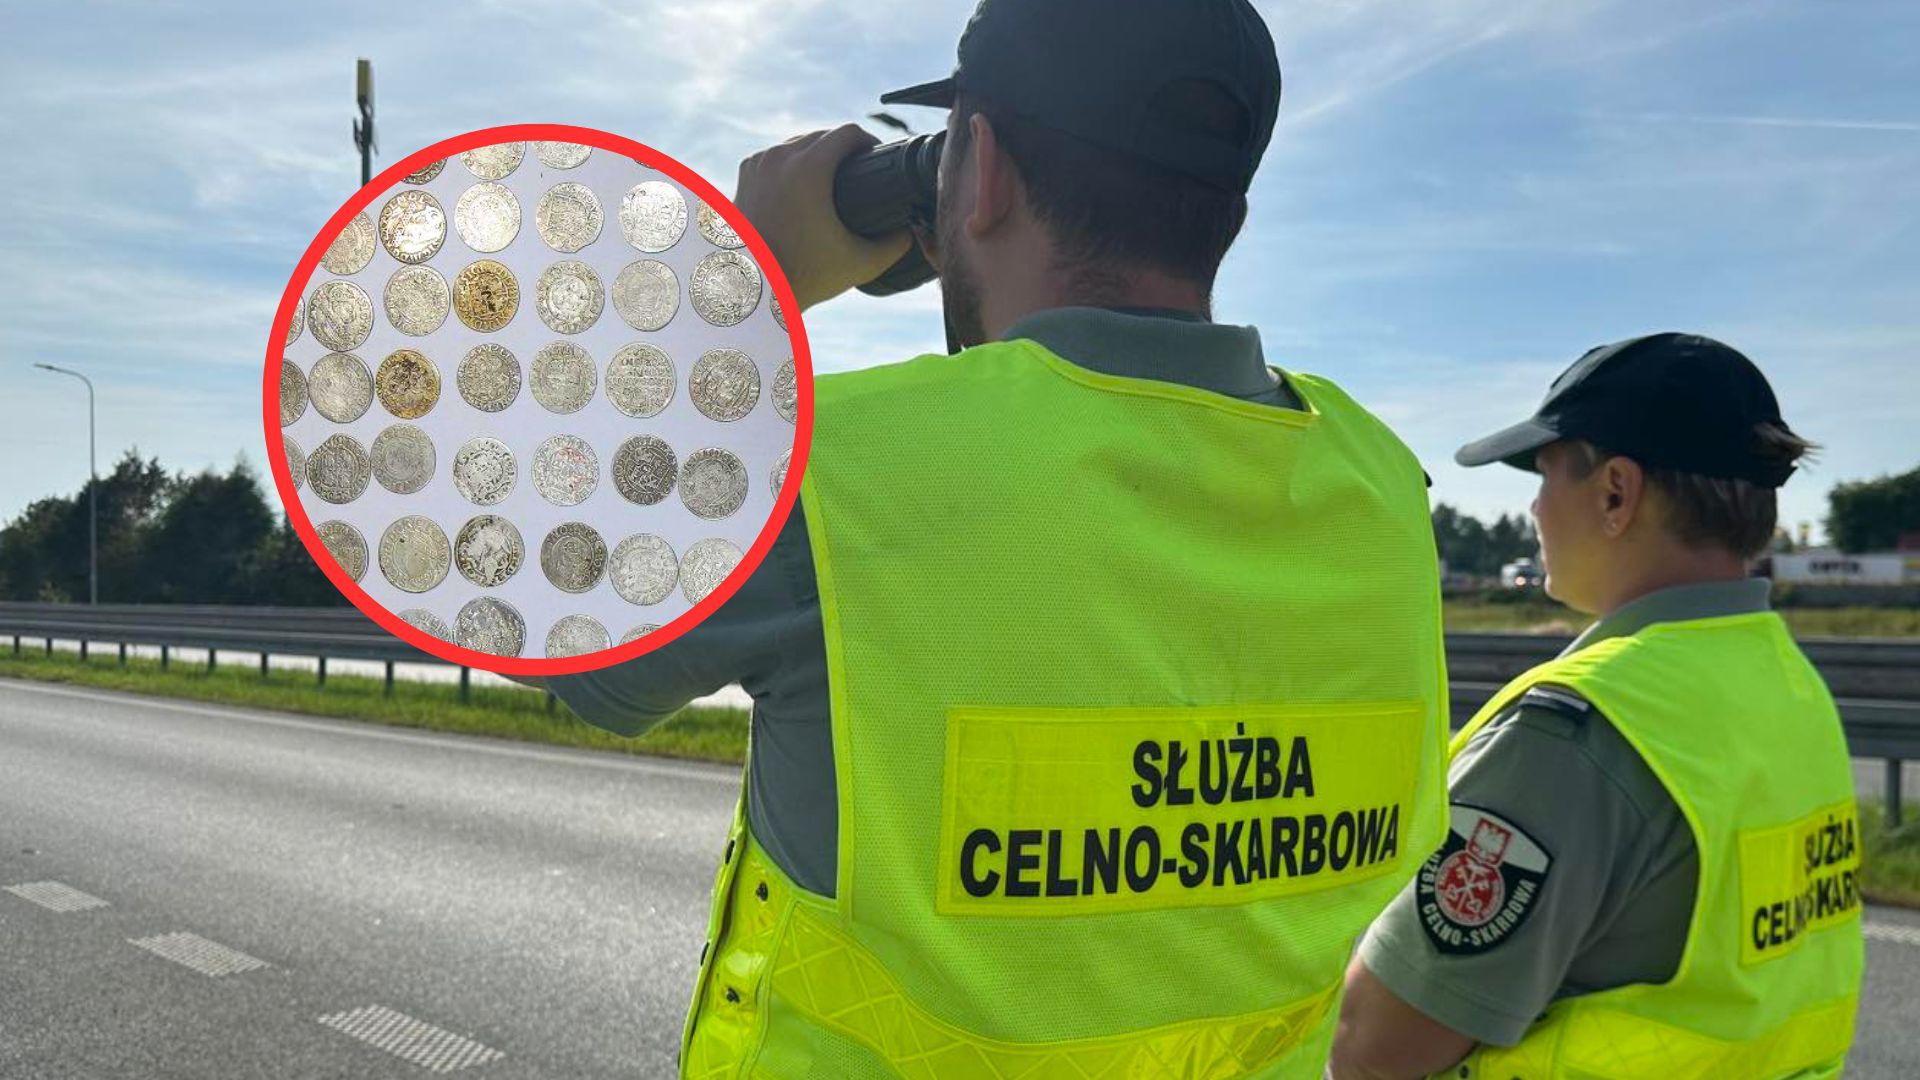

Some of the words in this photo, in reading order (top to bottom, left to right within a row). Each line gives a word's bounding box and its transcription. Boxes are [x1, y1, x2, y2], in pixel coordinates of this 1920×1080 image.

[1131, 722, 1315, 808] SŁUŻBA
[960, 804, 1400, 897] CELNO-SKARBOWA
[1423, 879, 1537, 946] CELNO-SKARBOWA
